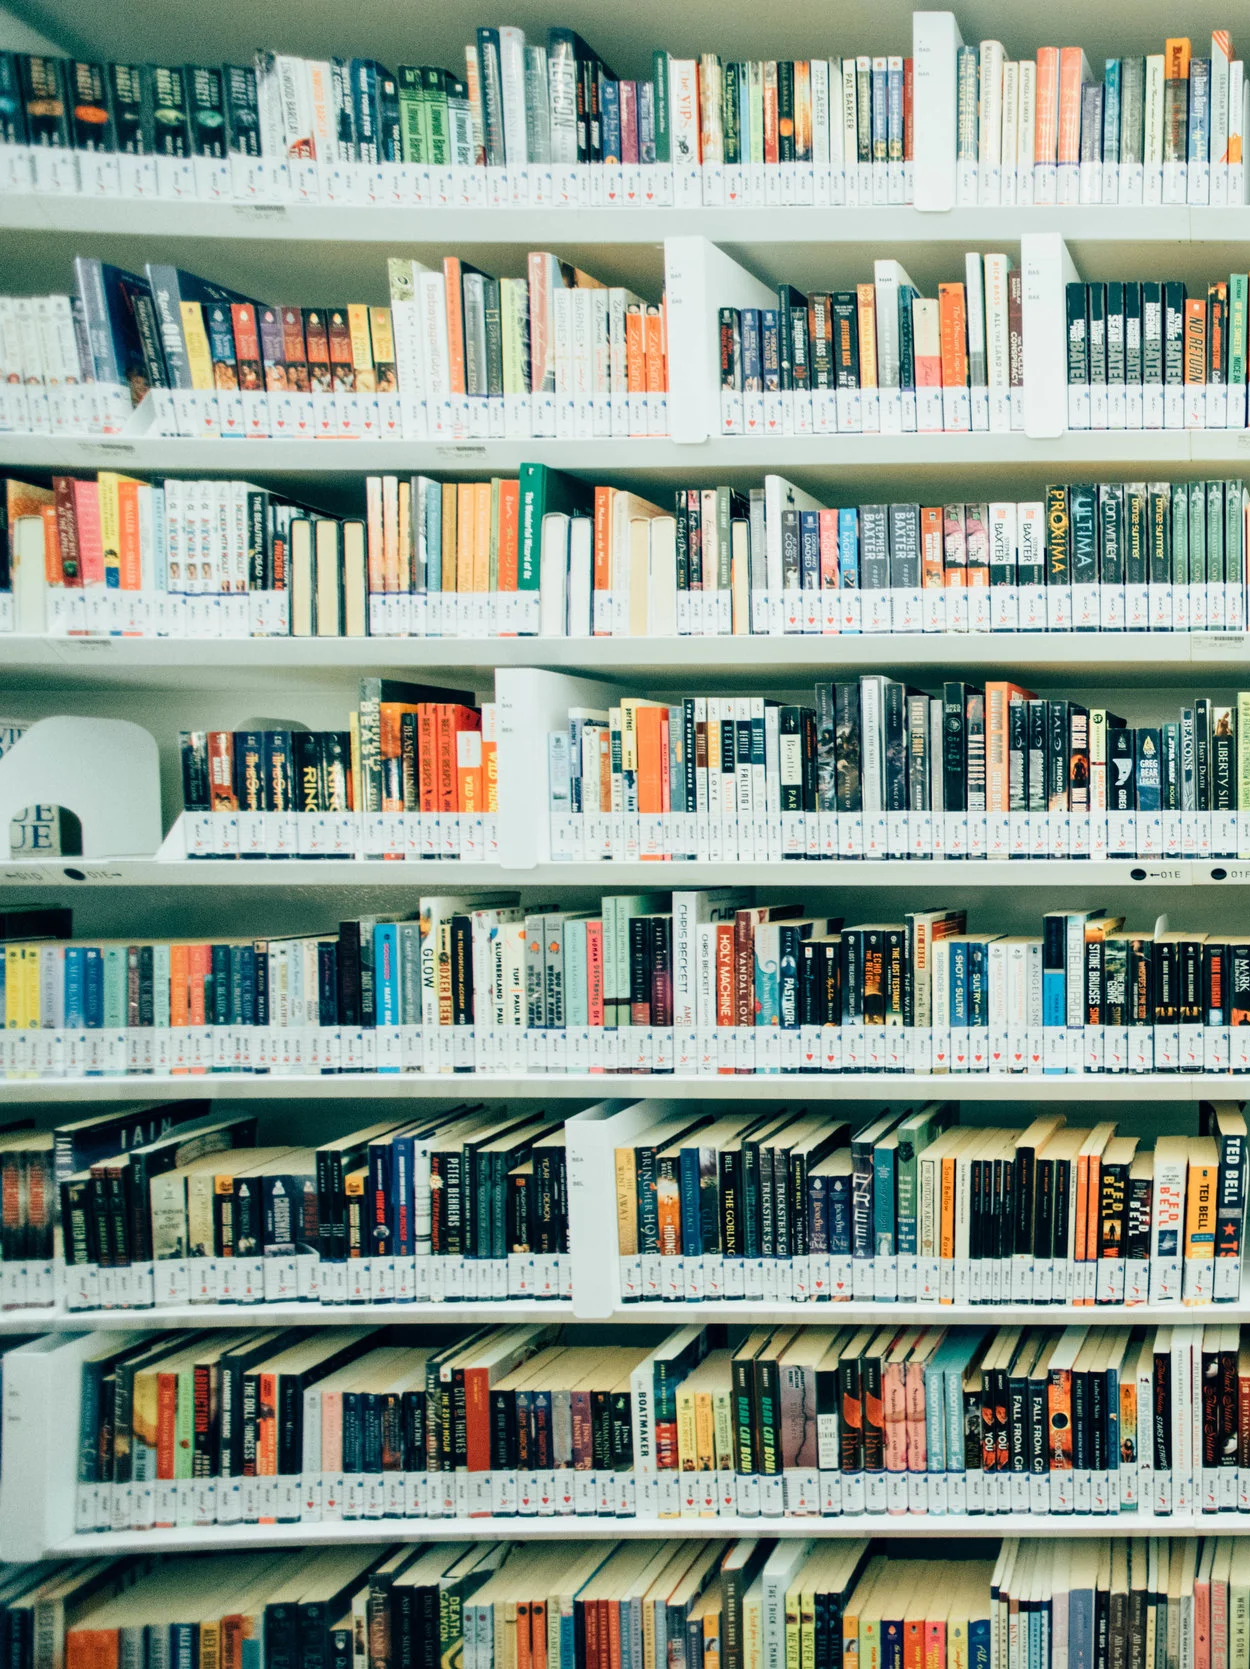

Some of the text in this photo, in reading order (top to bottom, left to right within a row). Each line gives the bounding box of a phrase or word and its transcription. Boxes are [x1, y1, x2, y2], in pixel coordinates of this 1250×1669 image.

[552, 62, 574, 128] LEXICON
[726, 89, 736, 126] Ingredients
[846, 73, 854, 129] PAT BARKER
[430, 104, 445, 138] Linwood
[728, 129, 736, 138] of
[728, 139, 736, 156] Love
[814, 304, 827, 356] JEFFERSON BASS
[1188, 316, 1204, 382] NO RETURN
[524, 504, 534, 538] Wonderful
[525, 492, 533, 504] The
[254, 512, 262, 552] BEAUTIFUL
[524, 540, 533, 562] Wizard
[785, 532, 794, 564] COST
[804, 532, 813, 568] LOADED
[864, 513, 884, 560] STEPHEN BAXTER
[894, 512, 916, 558] STEPHEN BAXTER
[994, 523, 1004, 562] BAXTER
[1050, 490, 1066, 573] PROXIMA
[1076, 498, 1092, 567] ULTIMA
[1130, 498, 1142, 559] bronze summer
[254, 555, 262, 576] DEAD
[523, 571, 532, 579] Oz
[724, 726, 733, 768] BEATTIE
[1183, 719, 1193, 770] BEACONS
[1217, 741, 1228, 787] LIBERTY
[1160, 870, 1182, 880] 01E
[423, 948, 434, 988] GLOW
[495, 942, 503, 1000] SLUMBERLAND
[678, 904, 688, 994] CHRIS BECKETT
[512, 968, 521, 1016] TUFF PAUL
[720, 935, 731, 1016] HOLY MACHINE
[738, 952, 748, 995] VANDAL
[1088, 944, 1100, 1004] STONE BRUISES
[724, 1155, 732, 1173] BELL
[1225, 1138, 1240, 1204] TED BELL
[448, 1158, 460, 1226] PETER BEHRENS
[776, 1183, 786, 1242] TRICKSTER'S
[1158, 1186, 1180, 1227] TED BELL
[1198, 1184, 1210, 1230] TED BELL
[194, 1368, 208, 1432] ABDUCTION
[222, 1370, 231, 1438] CHAMBER MUSIC
[762, 1396, 774, 1444] DEAD CAT
[638, 1392, 650, 1457] BOATMAKER
[1032, 1398, 1044, 1452] FALL FROM
[440, 1590, 460, 1642] DEATH CANYON
